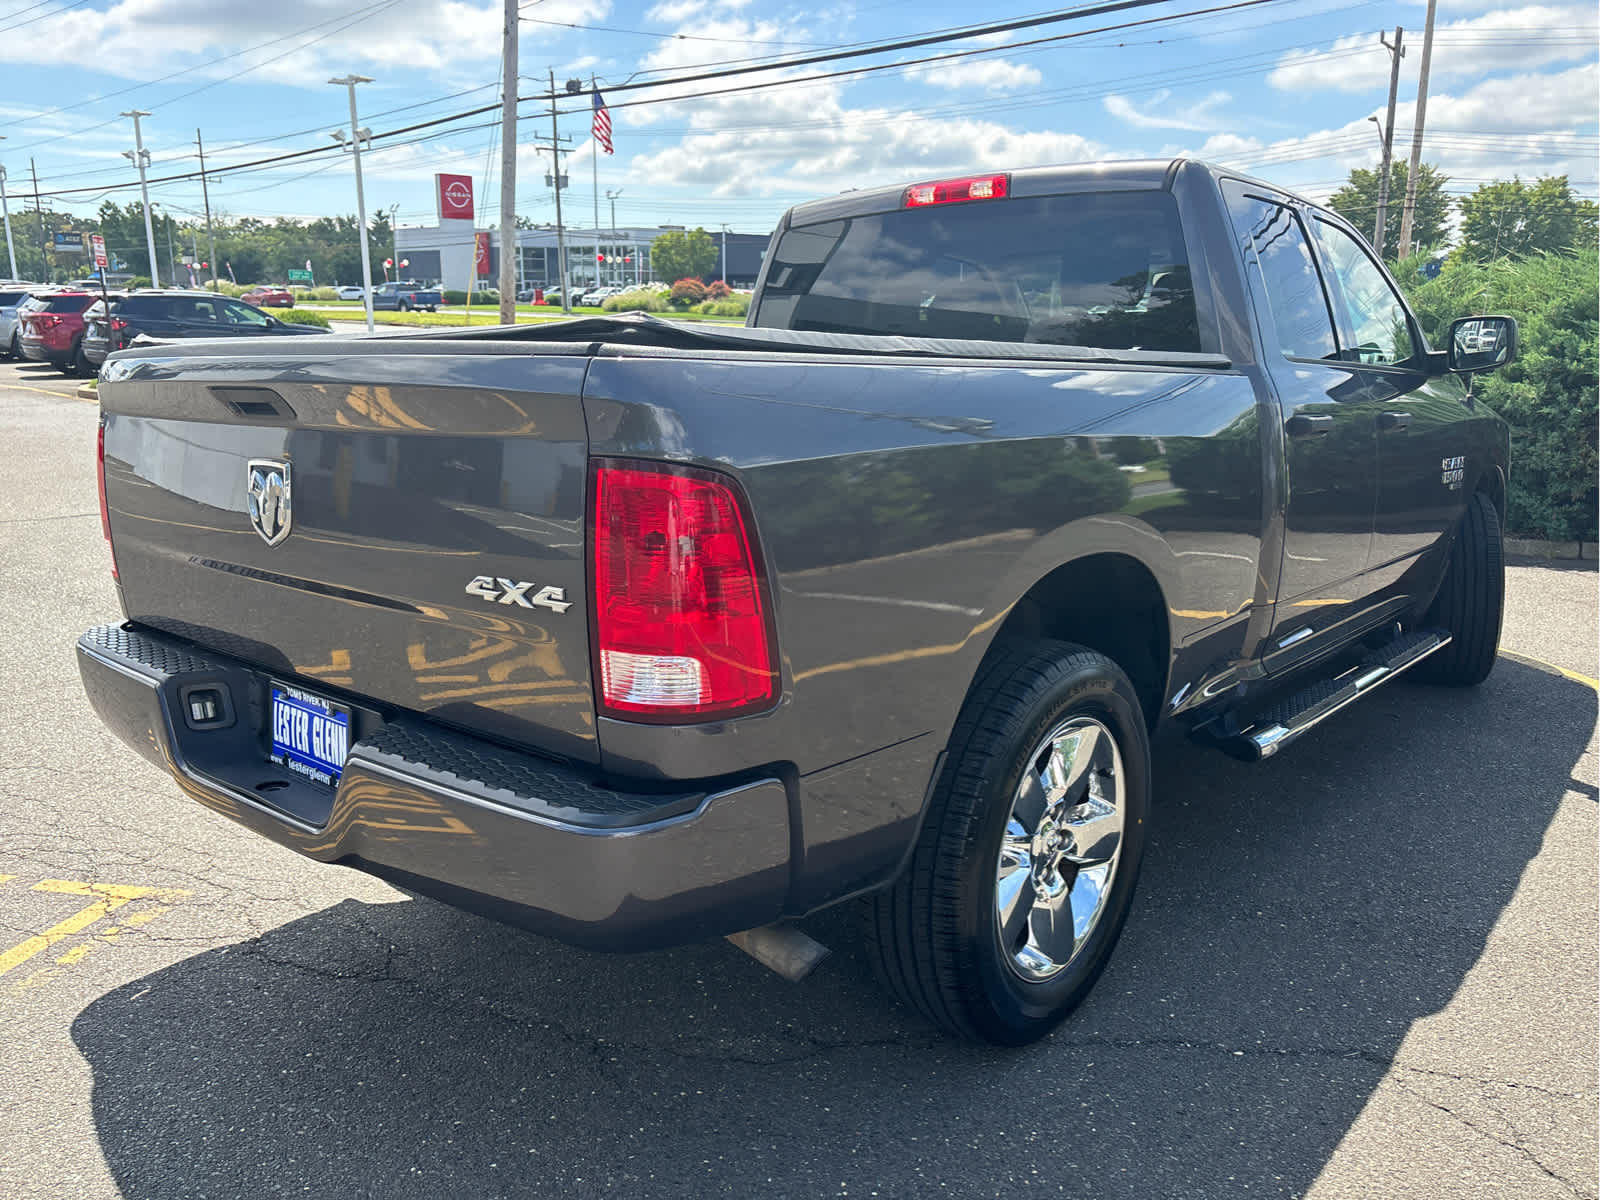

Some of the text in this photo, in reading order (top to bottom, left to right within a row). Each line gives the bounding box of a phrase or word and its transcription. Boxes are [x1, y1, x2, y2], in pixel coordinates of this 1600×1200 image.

[445, 191, 471, 199] NISSAN
[286, 687, 302, 701] TOMS
[273, 701, 347, 768] LESTER GLENN
